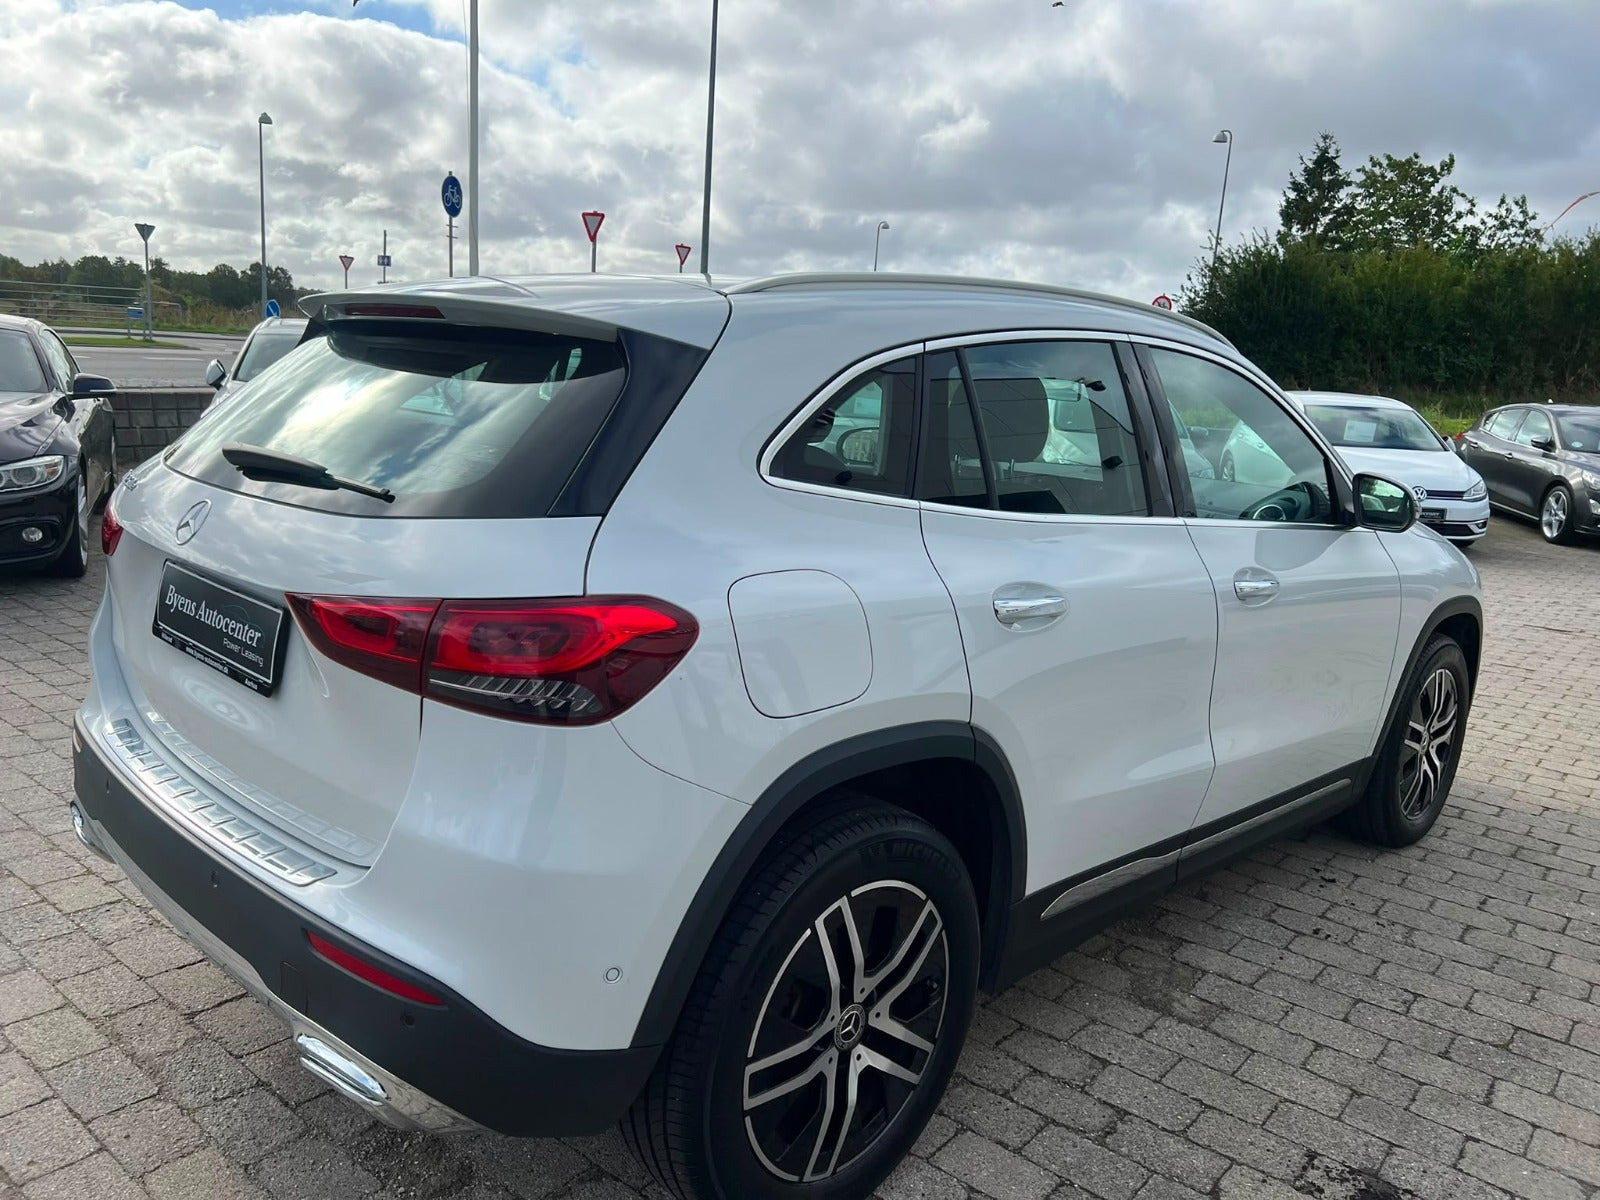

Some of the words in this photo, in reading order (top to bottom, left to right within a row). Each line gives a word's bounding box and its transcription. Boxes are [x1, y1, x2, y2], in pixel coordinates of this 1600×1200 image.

[165, 584, 197, 617] Byens
[196, 600, 262, 648] Autocenter
[223, 637, 241, 653] Power
[241, 647, 264, 668] Leasing
